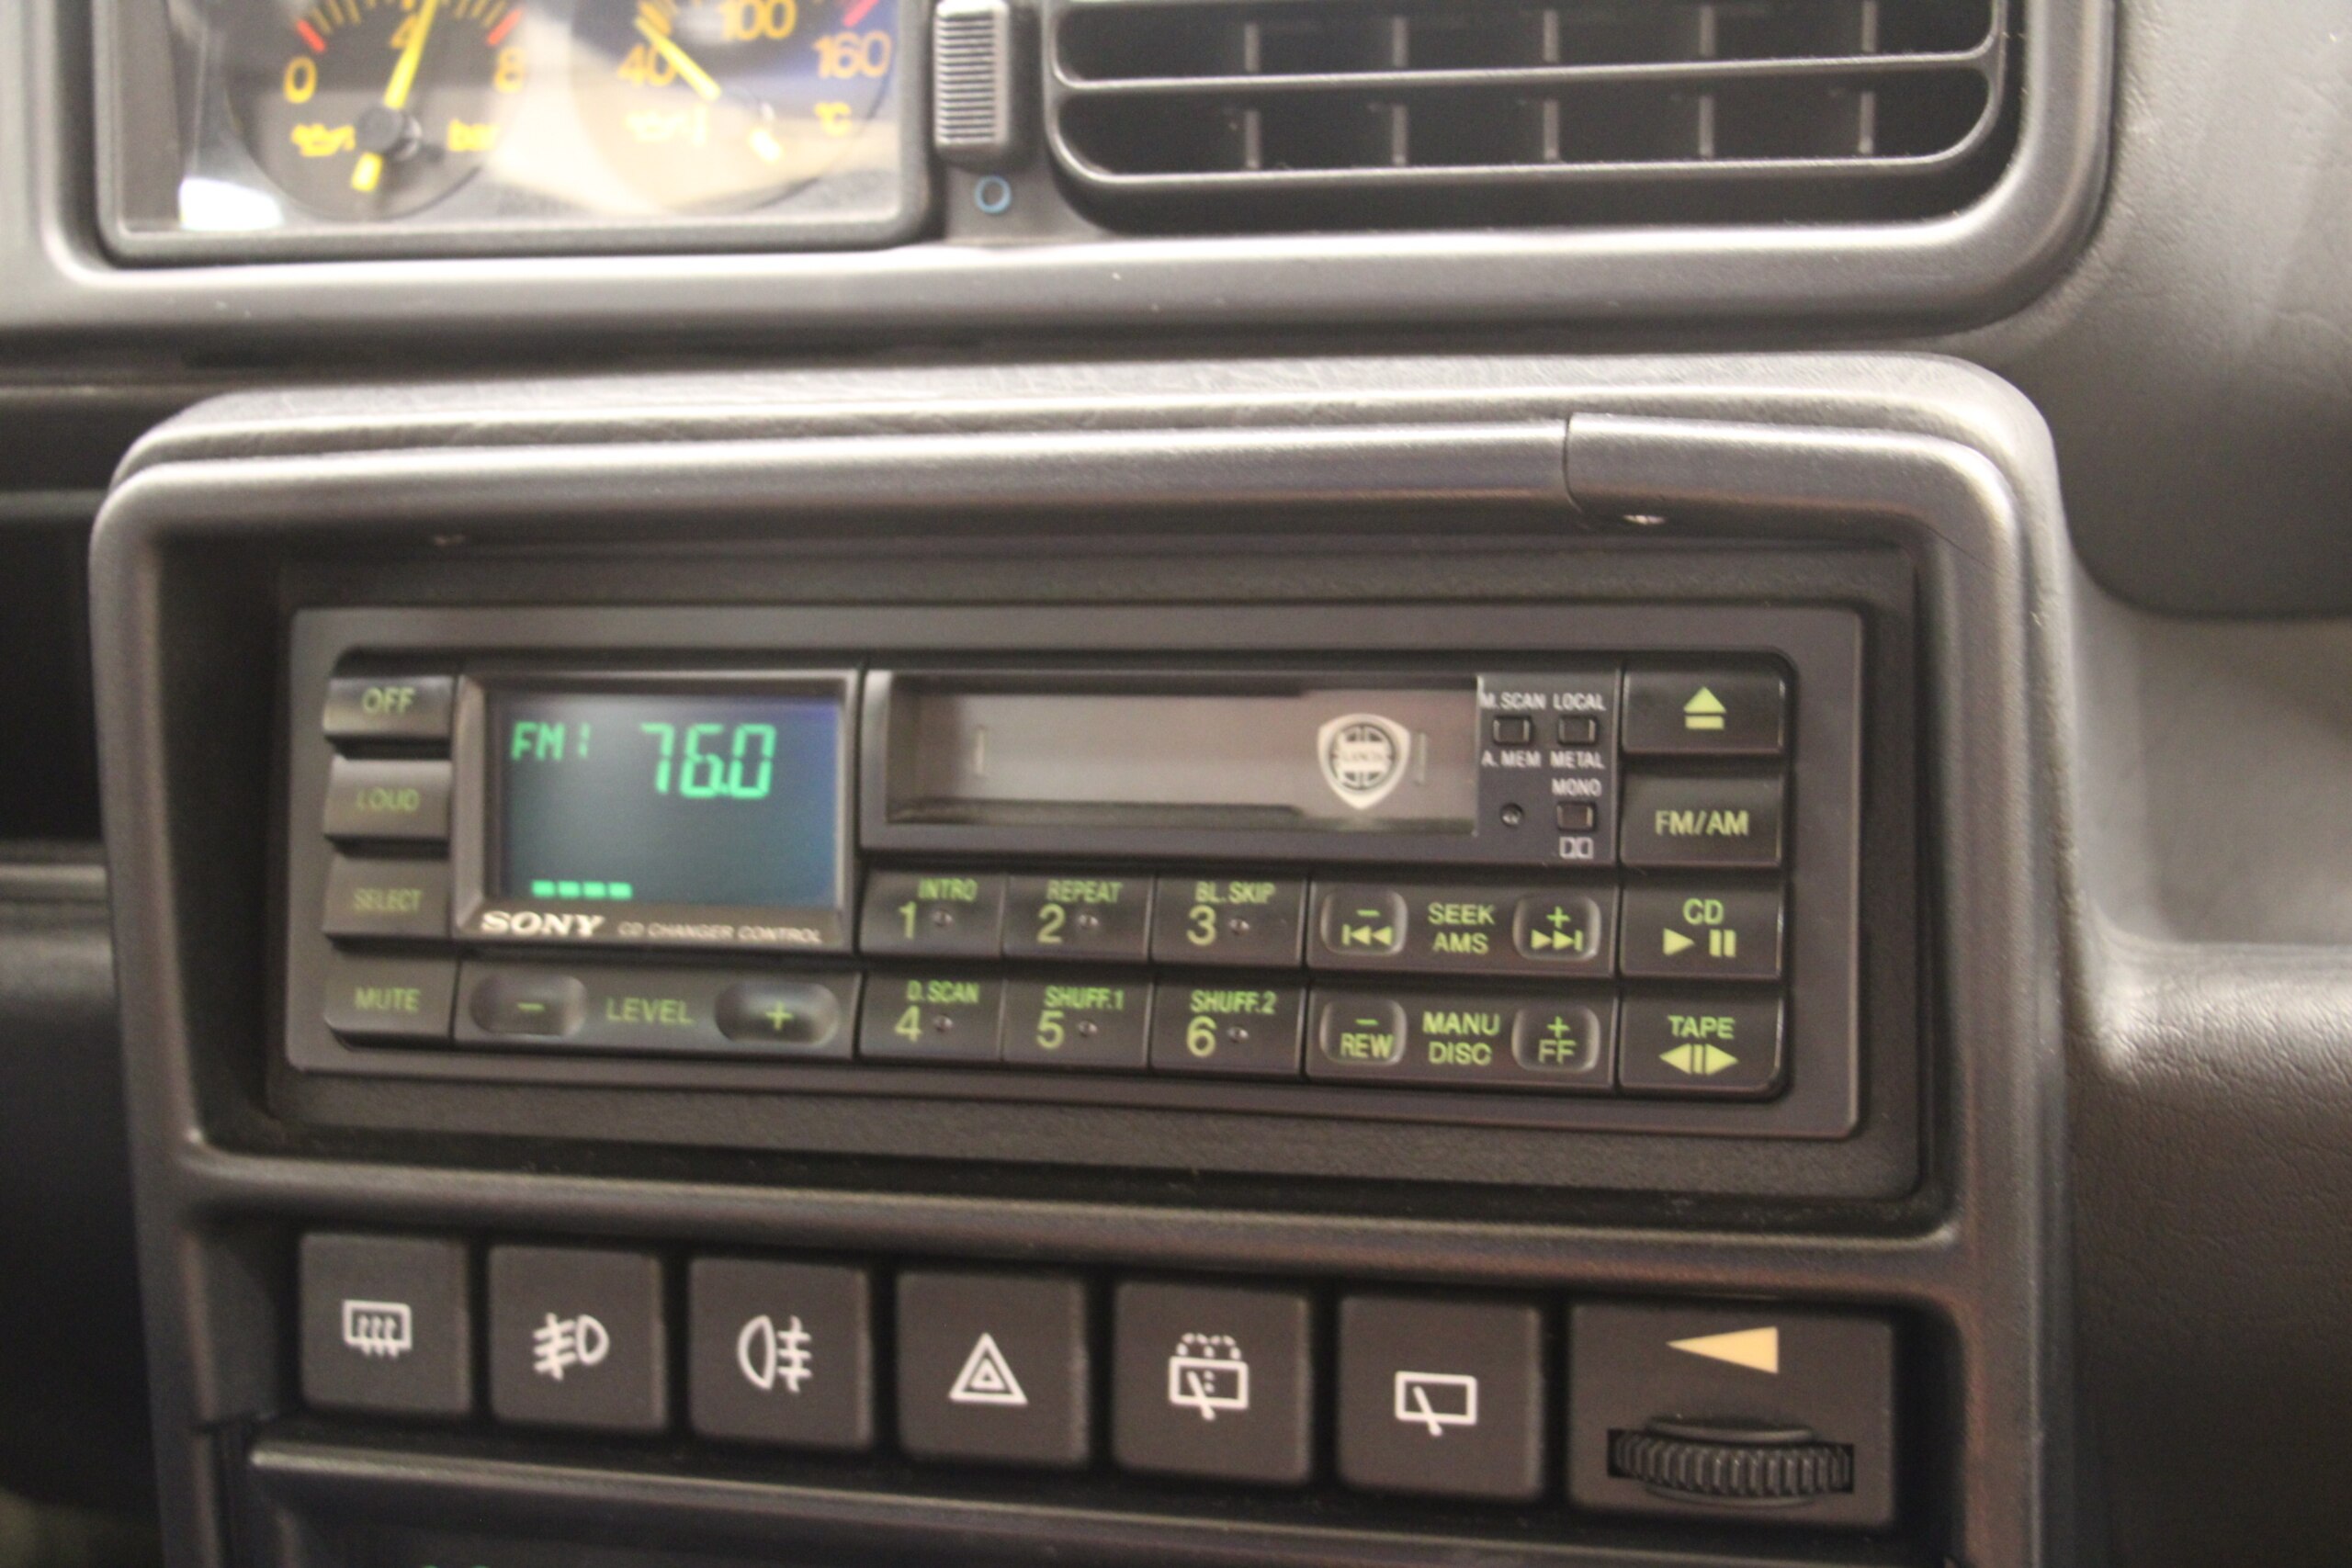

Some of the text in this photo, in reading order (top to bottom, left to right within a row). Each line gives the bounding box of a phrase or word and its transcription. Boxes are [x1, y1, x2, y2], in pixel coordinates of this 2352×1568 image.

[718, 0, 797, 41] 100
[616, 44, 678, 86] 40
[812, 30, 892, 79] 160
[283, 55, 318, 104] 0
[493, 46, 526, 94] 8
[362, 686, 416, 715] OFF
[1553, 693, 1606, 712] LOCAL
[1550, 751, 1605, 771] METAL
[356, 787, 421, 812] LOUD
[1552, 777, 1601, 797] MONO
[1655, 809, 1750, 837] FM/AM
[353, 887, 423, 913] SELECT
[917, 877, 979, 902] INTRO
[1046, 879, 1125, 904] REPEAT
[480, 910, 605, 938] SONY
[899, 900, 917, 940] 1
[1035, 903, 1067, 944] 2
[1427, 901, 1497, 927] SEEK
[1682, 897, 1724, 926] CD
[1185, 906, 1217, 947] 3
[1432, 931, 1489, 955] AMS
[355, 987, 421, 1012] MUTE
[605, 998, 693, 1025] LEVEL
[894, 1005, 922, 1044] 4
[1035, 1010, 1066, 1050] 5
[1186, 1015, 1217, 1057] 6
[1422, 1011, 1500, 1037] MANU
[1668, 1014, 1736, 1040] TAPE
[1340, 1032, 1395, 1060] REW
[1428, 1041, 1493, 1067] DISC
[1538, 1038, 1577, 1064] FF
